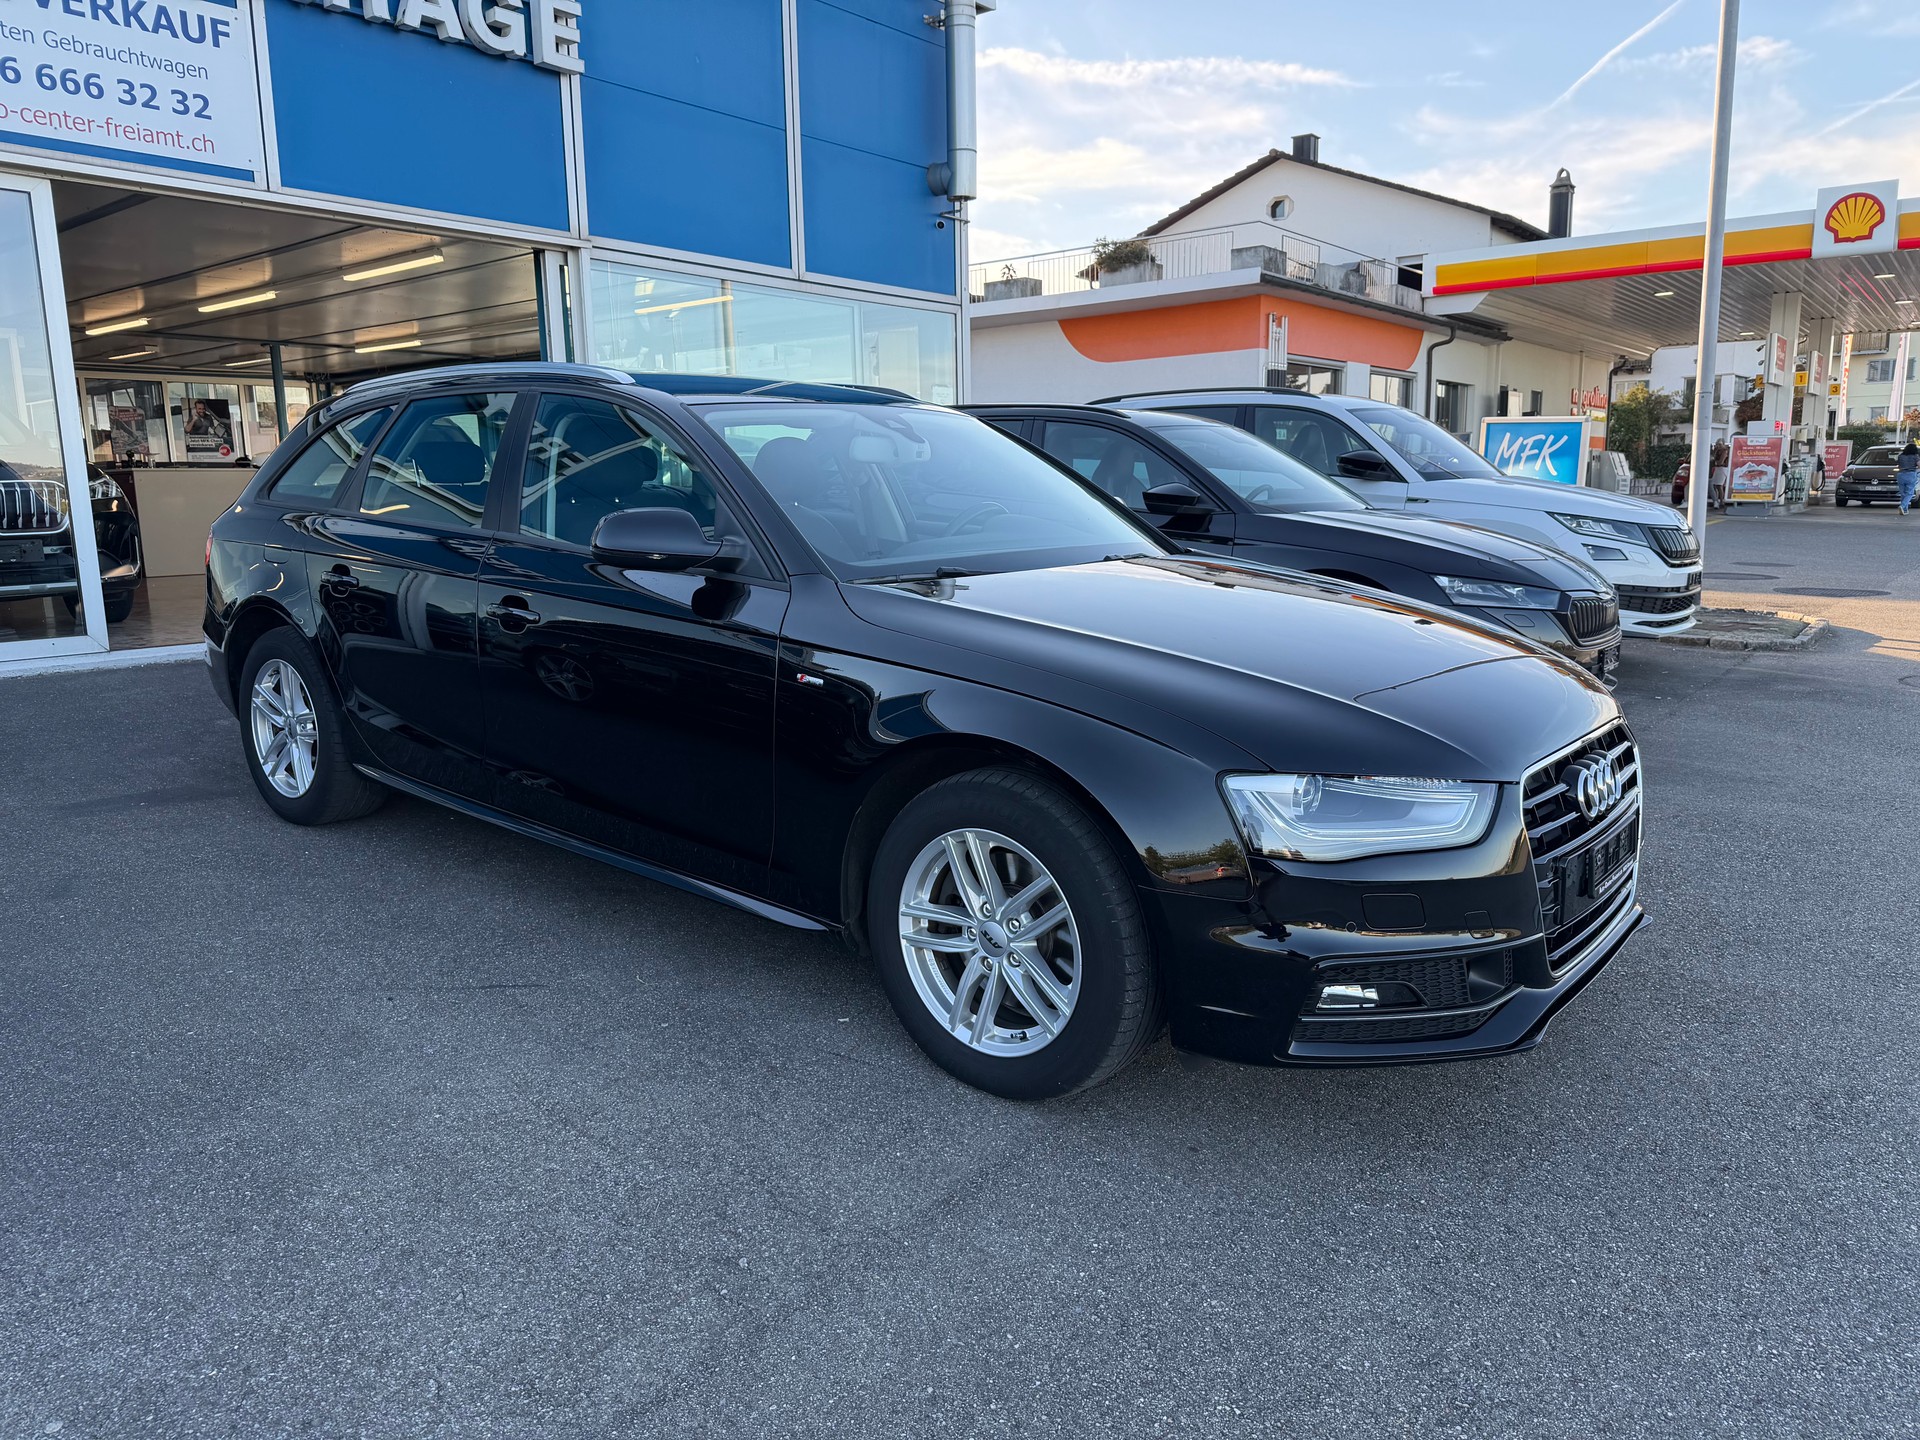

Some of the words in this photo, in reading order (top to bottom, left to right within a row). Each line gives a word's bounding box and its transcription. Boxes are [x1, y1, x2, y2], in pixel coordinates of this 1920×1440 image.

[35, 0, 231, 49] ERKAUF
[43, 30, 209, 80] Gebrauchtwagen
[0, 56, 22, 84] 6
[35, 63, 105, 100] 666
[116, 78, 161, 111] 32
[170, 89, 213, 120] 32
[1493, 432, 1569, 477] MFK
